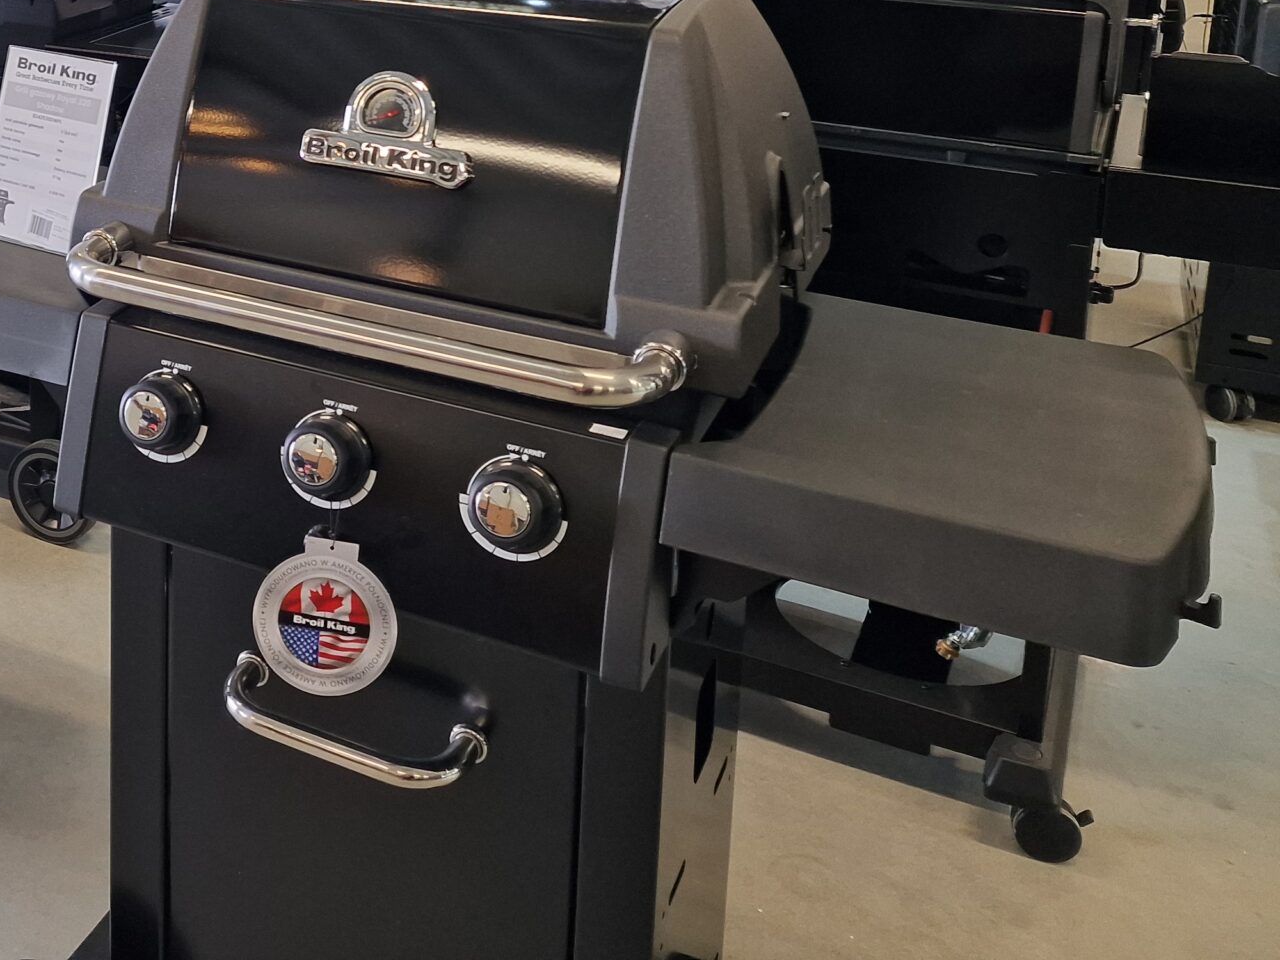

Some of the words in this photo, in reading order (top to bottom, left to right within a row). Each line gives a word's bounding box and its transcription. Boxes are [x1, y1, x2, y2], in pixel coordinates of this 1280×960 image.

[17, 56, 56, 75] Broil
[60, 64, 97, 86] King
[306, 136, 378, 165] Broil
[387, 148, 458, 182] King
[293, 614, 324, 628] Broil
[326, 620, 357, 635] King
